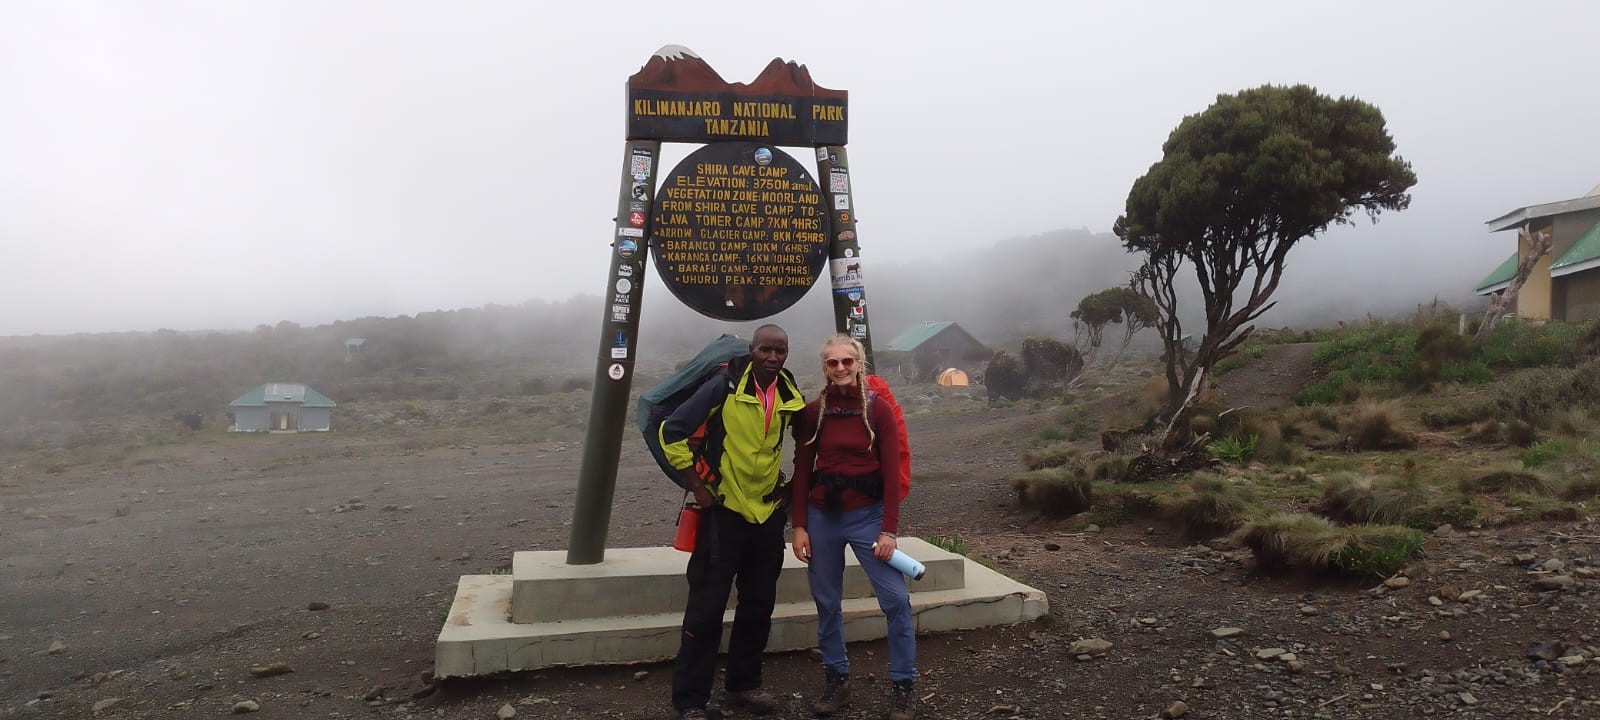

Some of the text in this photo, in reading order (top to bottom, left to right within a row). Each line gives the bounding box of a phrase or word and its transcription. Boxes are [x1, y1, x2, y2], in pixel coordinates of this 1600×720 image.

[634, 99, 844, 121] KILIMANJARO NATIONAL PARK
[705, 118, 769, 137] TANZANIA
[697, 163, 788, 178] SHIRA CAVE CAMP
[677, 175, 749, 188] ELEVATION:
[666, 188, 730, 200] VEGETATION
[662, 201, 692, 212] FROM
[695, 202, 727, 213] SHIRA
[731, 203, 757, 214] CAVE
[765, 204, 794, 216] CAMP
[695, 215, 731, 227] TOWER
[736, 216, 765, 228] CAMP
[700, 228, 740, 239] GLACIER
[742, 231, 769, 241] CAMP:
[667, 240, 715, 251] BARANCO
[782, 243, 812, 253] (6HRS)
[667, 252, 710, 262] KARANGA
[712, 253, 741, 263] CAMP:
[678, 264, 717, 273] BARAFU
[682, 275, 719, 285] UHURU
